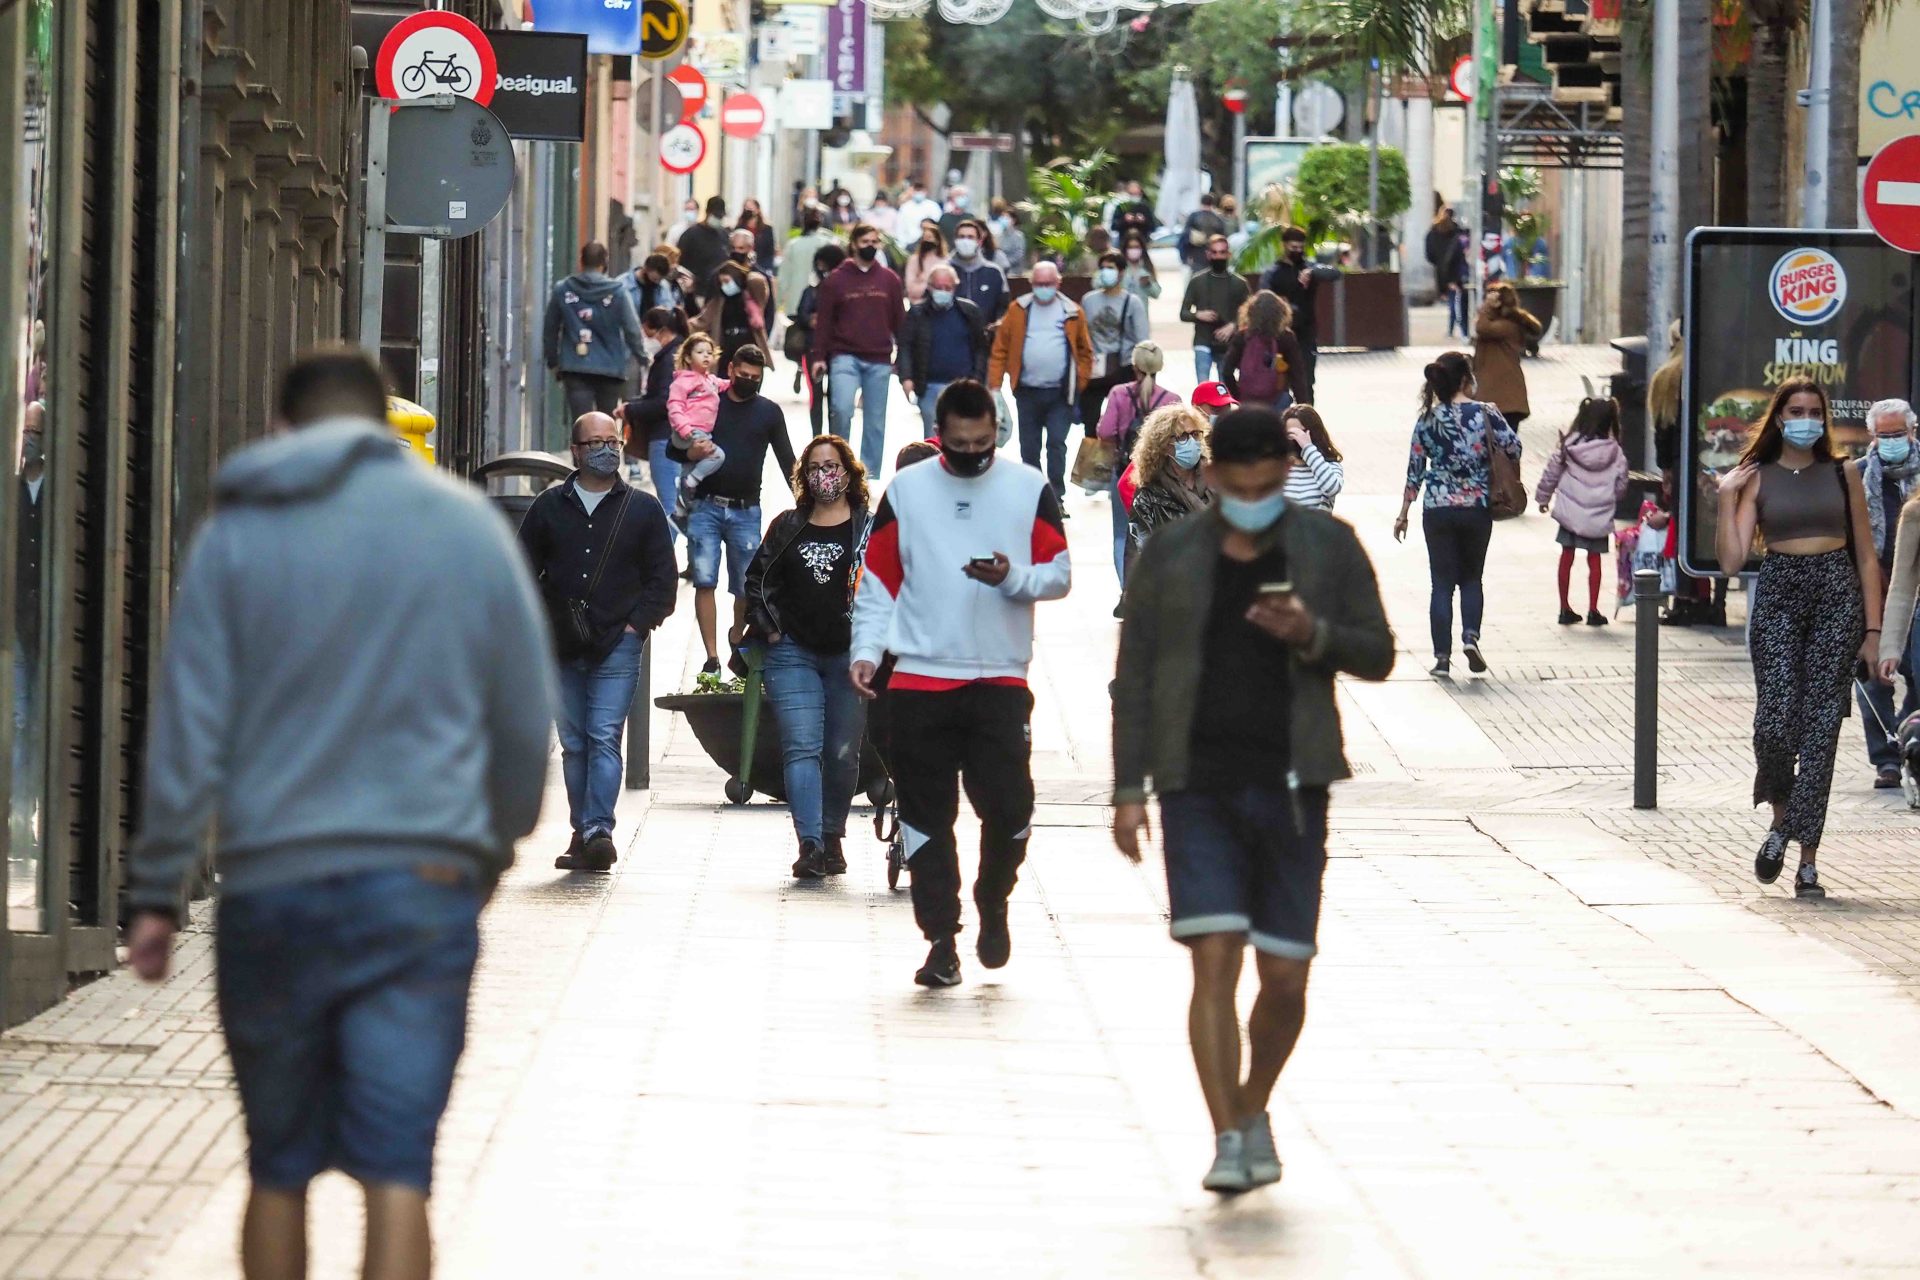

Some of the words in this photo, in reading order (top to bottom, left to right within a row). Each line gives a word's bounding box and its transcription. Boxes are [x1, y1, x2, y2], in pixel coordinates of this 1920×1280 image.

[642, 11, 678, 41] N
[1780, 263, 1835, 288] BURGER
[1782, 275, 1837, 306] KING
[1775, 338, 1838, 366] KING
[1830, 399, 1876, 410] TRUFAD
